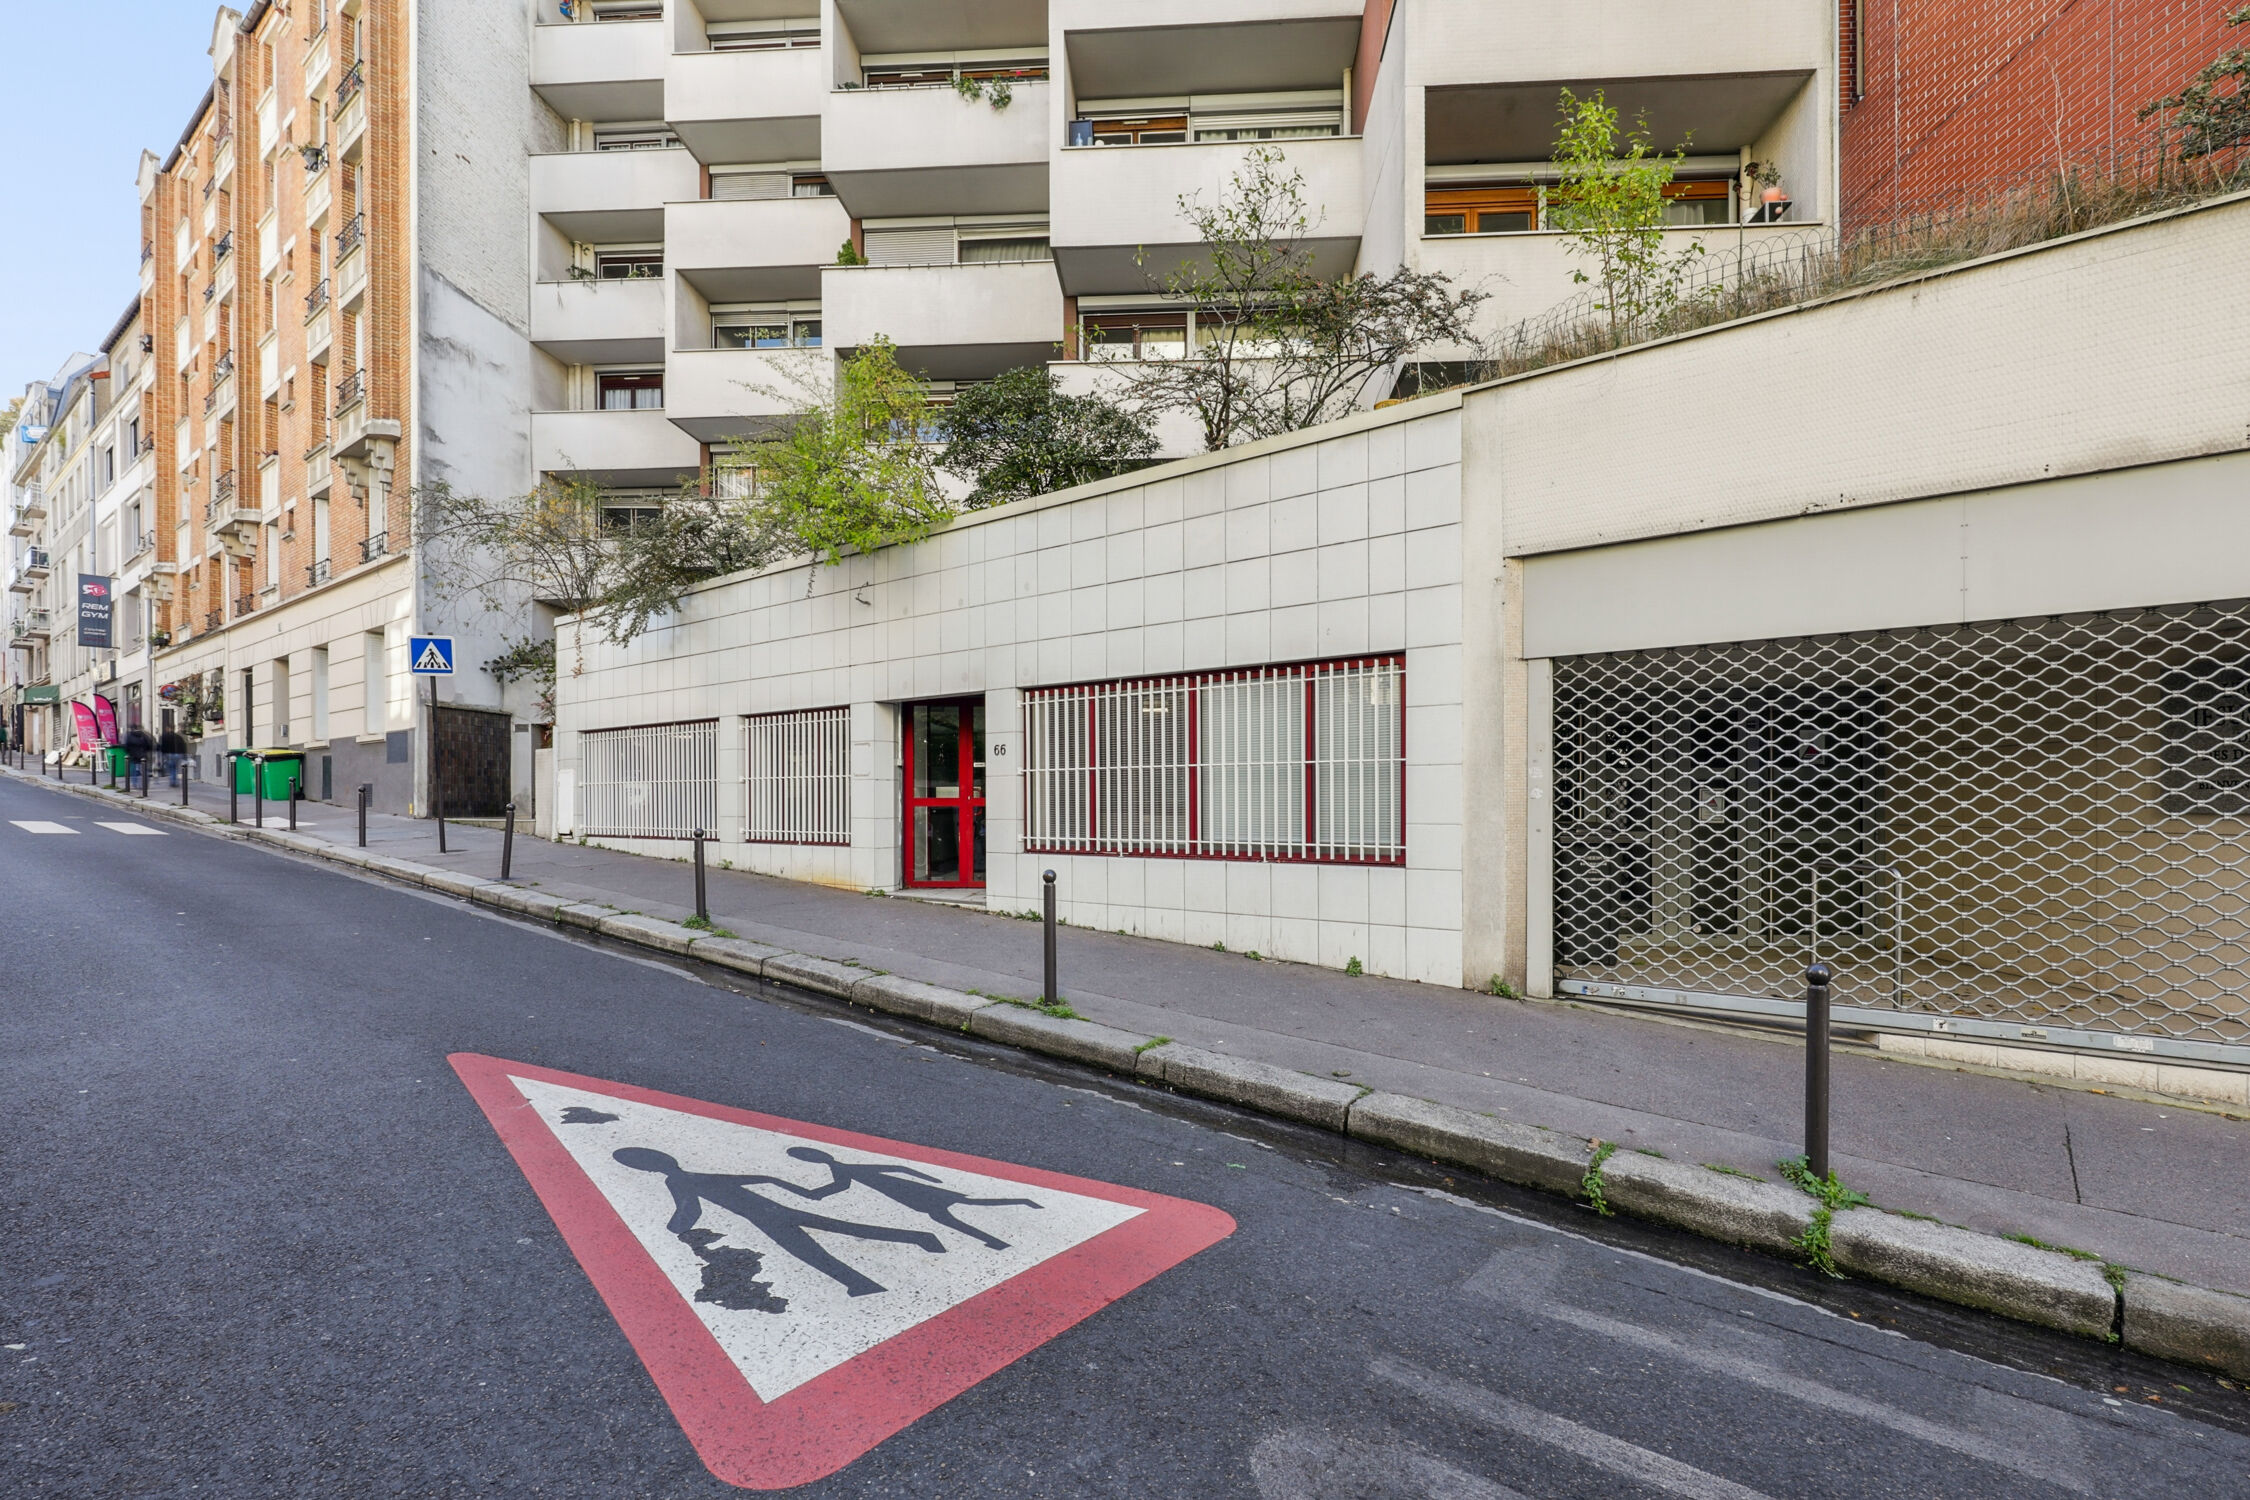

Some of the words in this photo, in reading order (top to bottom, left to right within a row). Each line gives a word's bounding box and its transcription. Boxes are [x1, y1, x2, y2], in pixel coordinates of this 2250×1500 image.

[81, 602, 109, 611] REM
[81, 610, 109, 620] GYM
[993, 744, 1006, 756] 66
